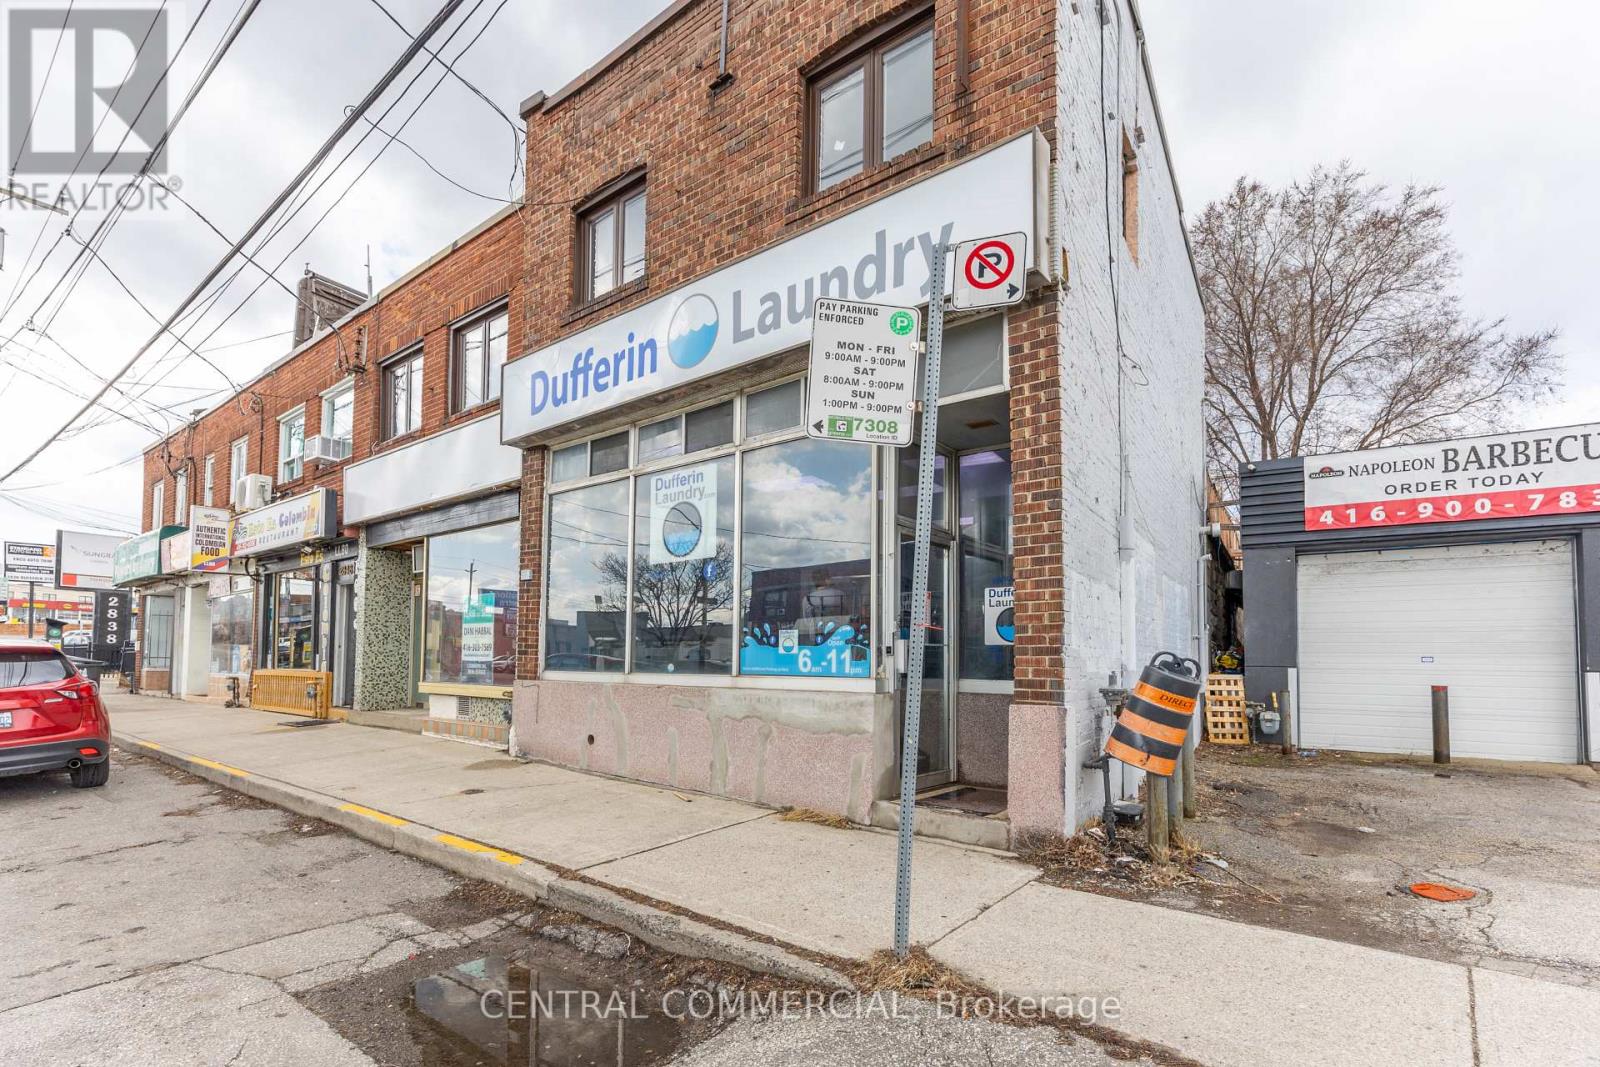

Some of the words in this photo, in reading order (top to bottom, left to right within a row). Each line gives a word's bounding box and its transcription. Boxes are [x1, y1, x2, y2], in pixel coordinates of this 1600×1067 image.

[819, 301, 837, 312] PAY
[839, 303, 879, 317] PARKING
[530, 332, 658, 416] Dufferin
[732, 221, 954, 344] Laundry
[818, 312, 865, 326] ENFORCED
[836, 340, 865, 353] MON
[876, 343, 896, 355] FRI
[824, 351, 862, 364] 9:00AM
[870, 355, 906, 368] 9:00PM
[853, 365, 877, 376] SAT
[823, 375, 860, 387] 8:00AM
[868, 378, 905, 391] 9:00PM
[851, 389, 875, 400] SUN
[823, 399, 858, 411] 1:00PM
[867, 402, 902, 414] 9:00PM
[854, 418, 899, 434] 7308
[1348, 457, 1436, 477] NAPOLEON
[1441, 432, 1600, 474] BARBECU
[655, 470, 704, 492] Dufferin
[1384, 479, 1458, 495] ORDER
[1467, 471, 1545, 489] TODAY
[196, 525, 226, 535] AUTHENTIC
[195, 539, 226, 549] COLOMBIAN
[200, 547, 220, 557] FOOD
[1160, 694, 1194, 708] DIRECT
